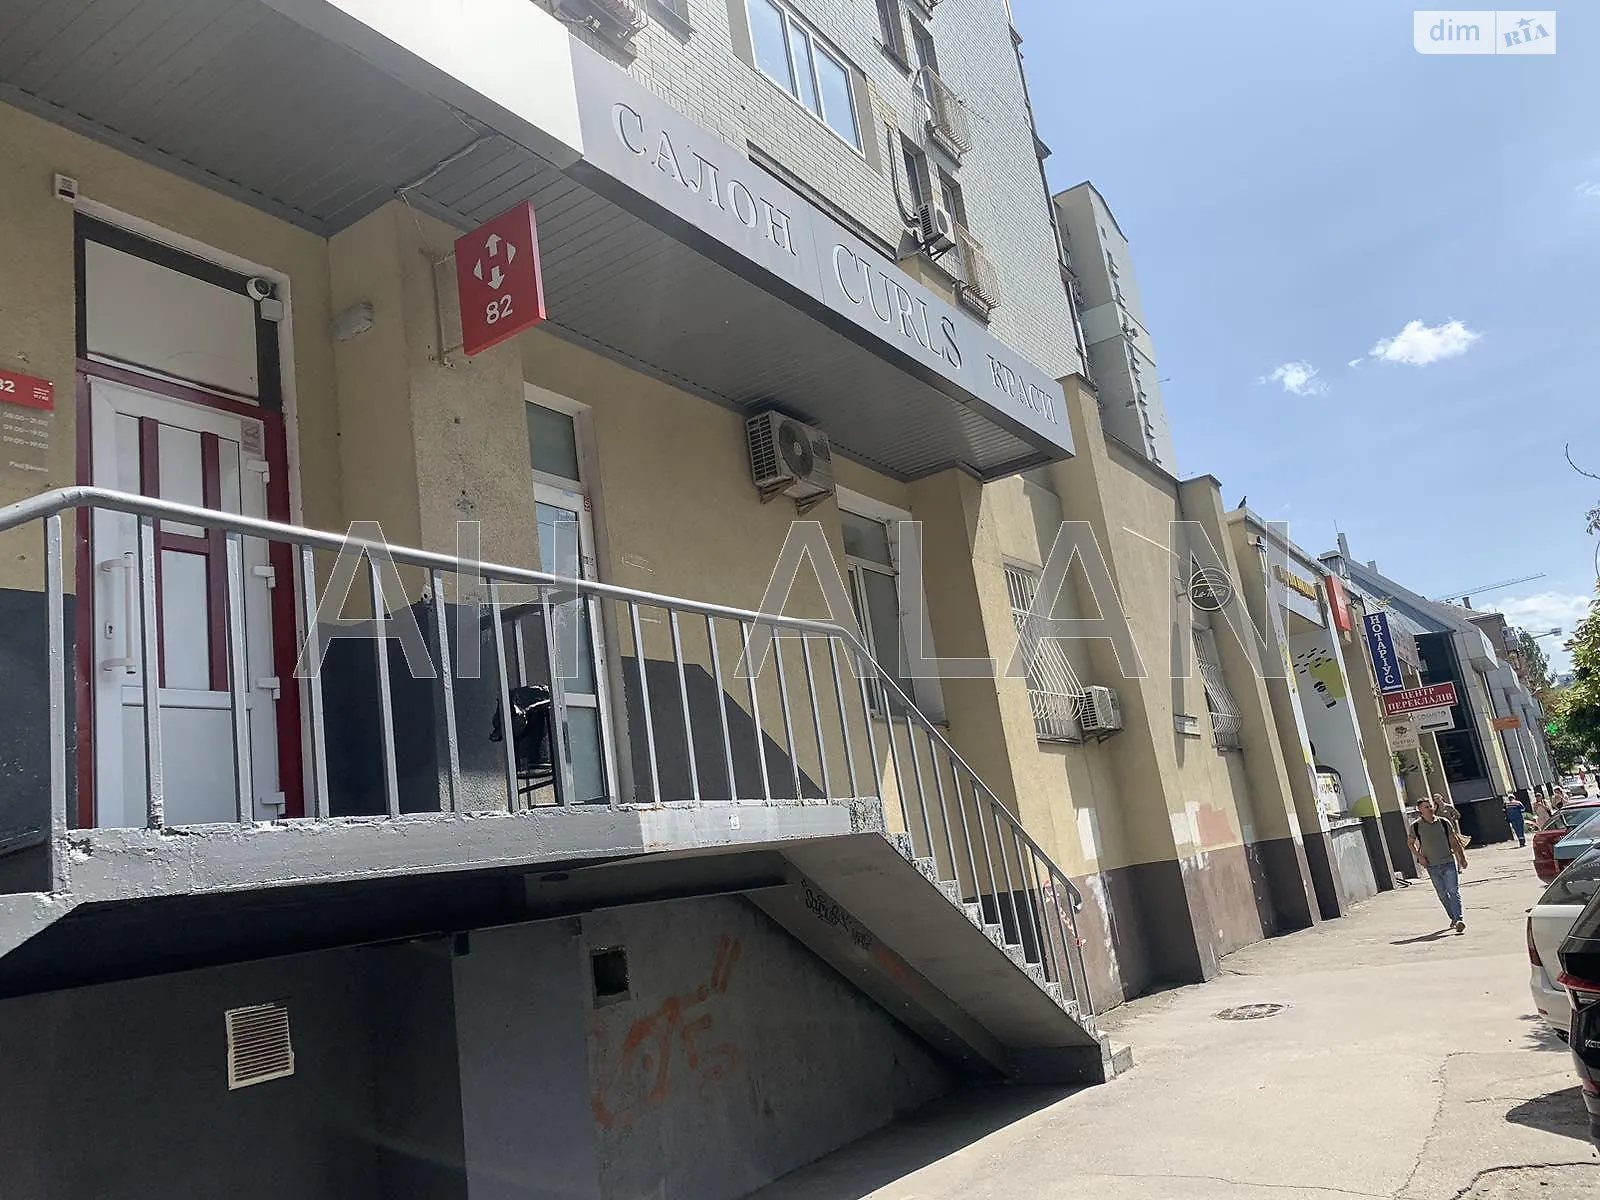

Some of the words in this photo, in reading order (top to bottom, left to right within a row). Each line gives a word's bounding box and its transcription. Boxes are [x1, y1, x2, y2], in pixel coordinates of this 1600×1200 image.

[611, 102, 797, 257] САЛОН
[832, 243, 963, 370] CURLS
[486, 294, 513, 325] 82
[1369, 614, 1394, 684] НОТАРІУС
[1388, 692, 1453, 711] ПЕРЕКЛАДІВ
[1401, 688, 1434, 700] ЦЕНТР
